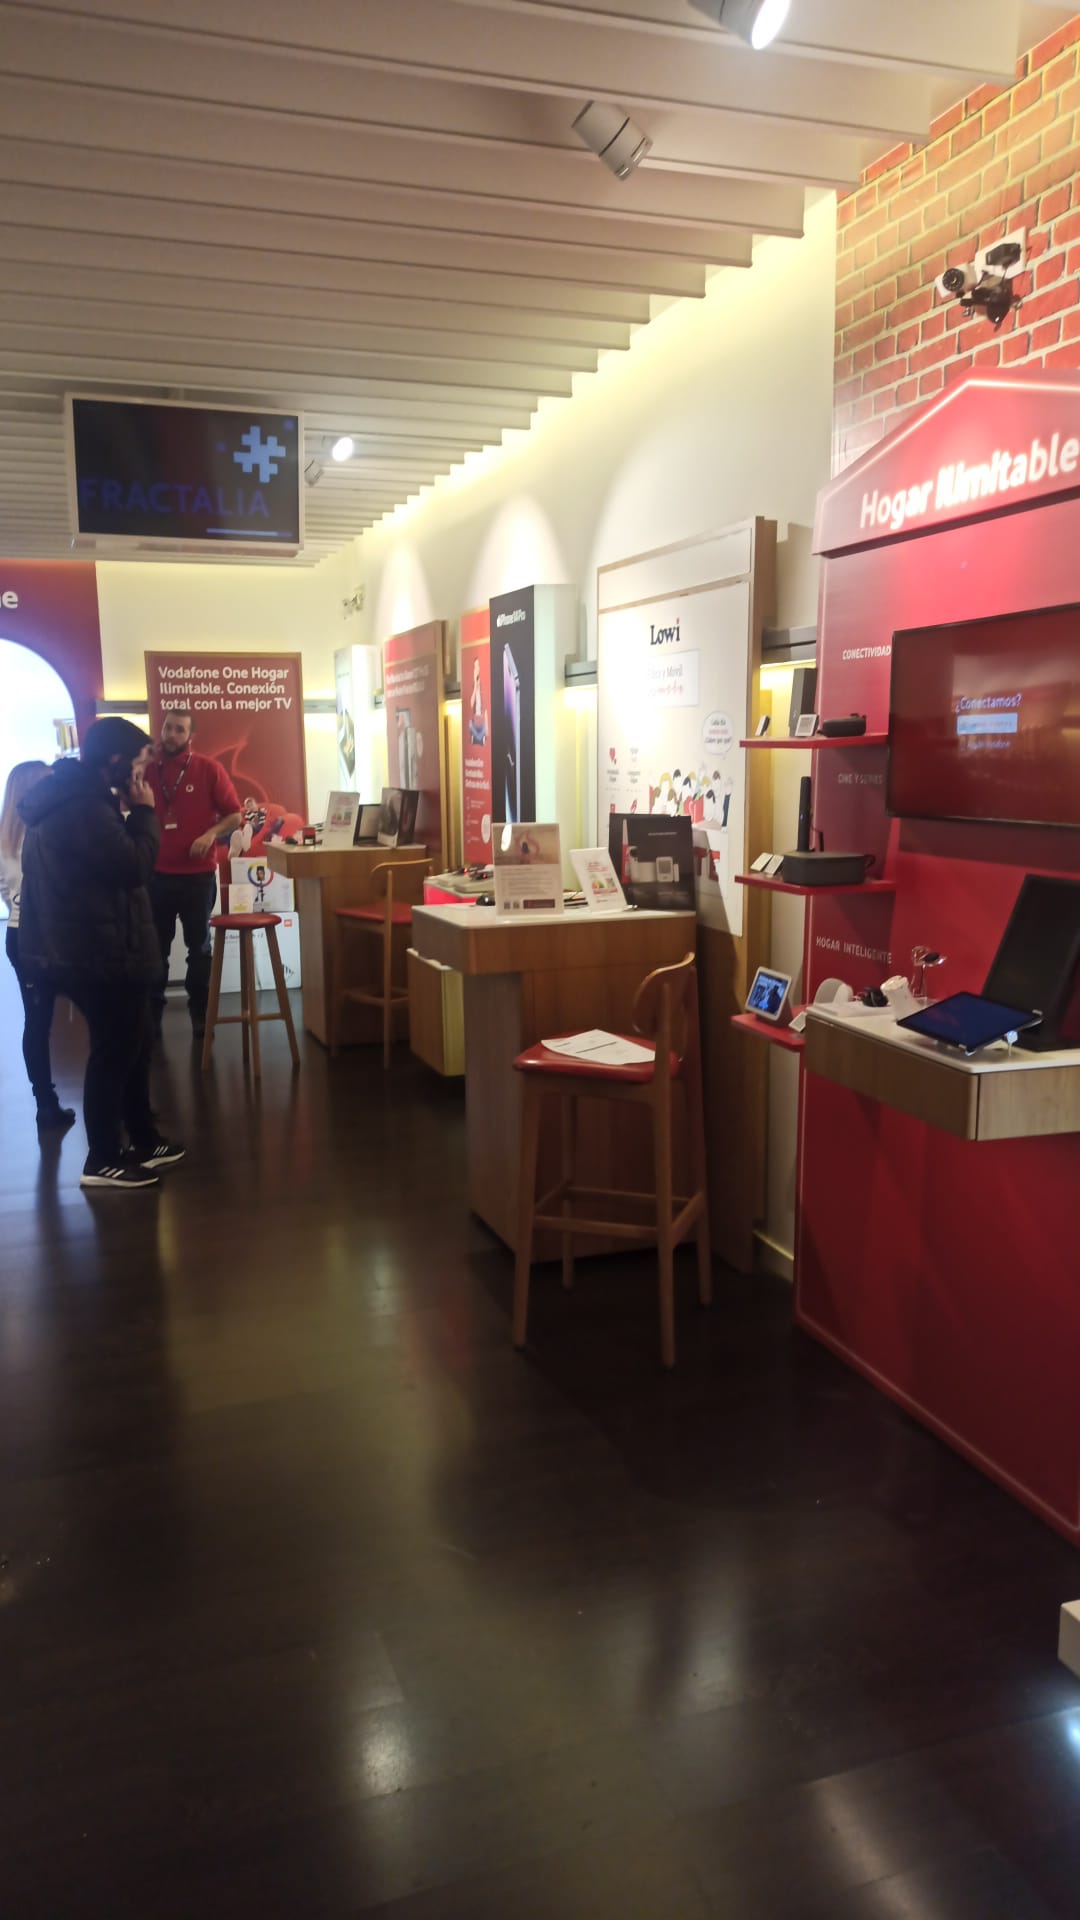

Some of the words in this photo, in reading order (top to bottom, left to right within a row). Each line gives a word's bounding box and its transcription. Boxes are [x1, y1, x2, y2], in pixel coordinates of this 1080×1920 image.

[860, 480, 933, 529] Hogar
[935, 432, 1080, 509] Ilimitable
[79, 478, 270, 519] FRACTALIA
[650, 617, 681, 646] Lowi
[842, 645, 892, 661] CONECTIVIDAD
[158, 666, 219, 679] Vodafone
[222, 666, 248, 679] One
[251, 666, 289, 681] Hogar
[159, 682, 224, 695] Ilimitable.
[226, 681, 285, 695] Conexión
[160, 698, 191, 710] total
[194, 700, 217, 710] con
[221, 698, 232, 710] la
[235, 698, 272, 712] mejor
[274, 697, 292, 710] TV
[955, 693, 1022, 713] ¿Conectamos?
[816, 935, 841, 953] HOGAR
[843, 941, 892, 965] INTELIGENTE
